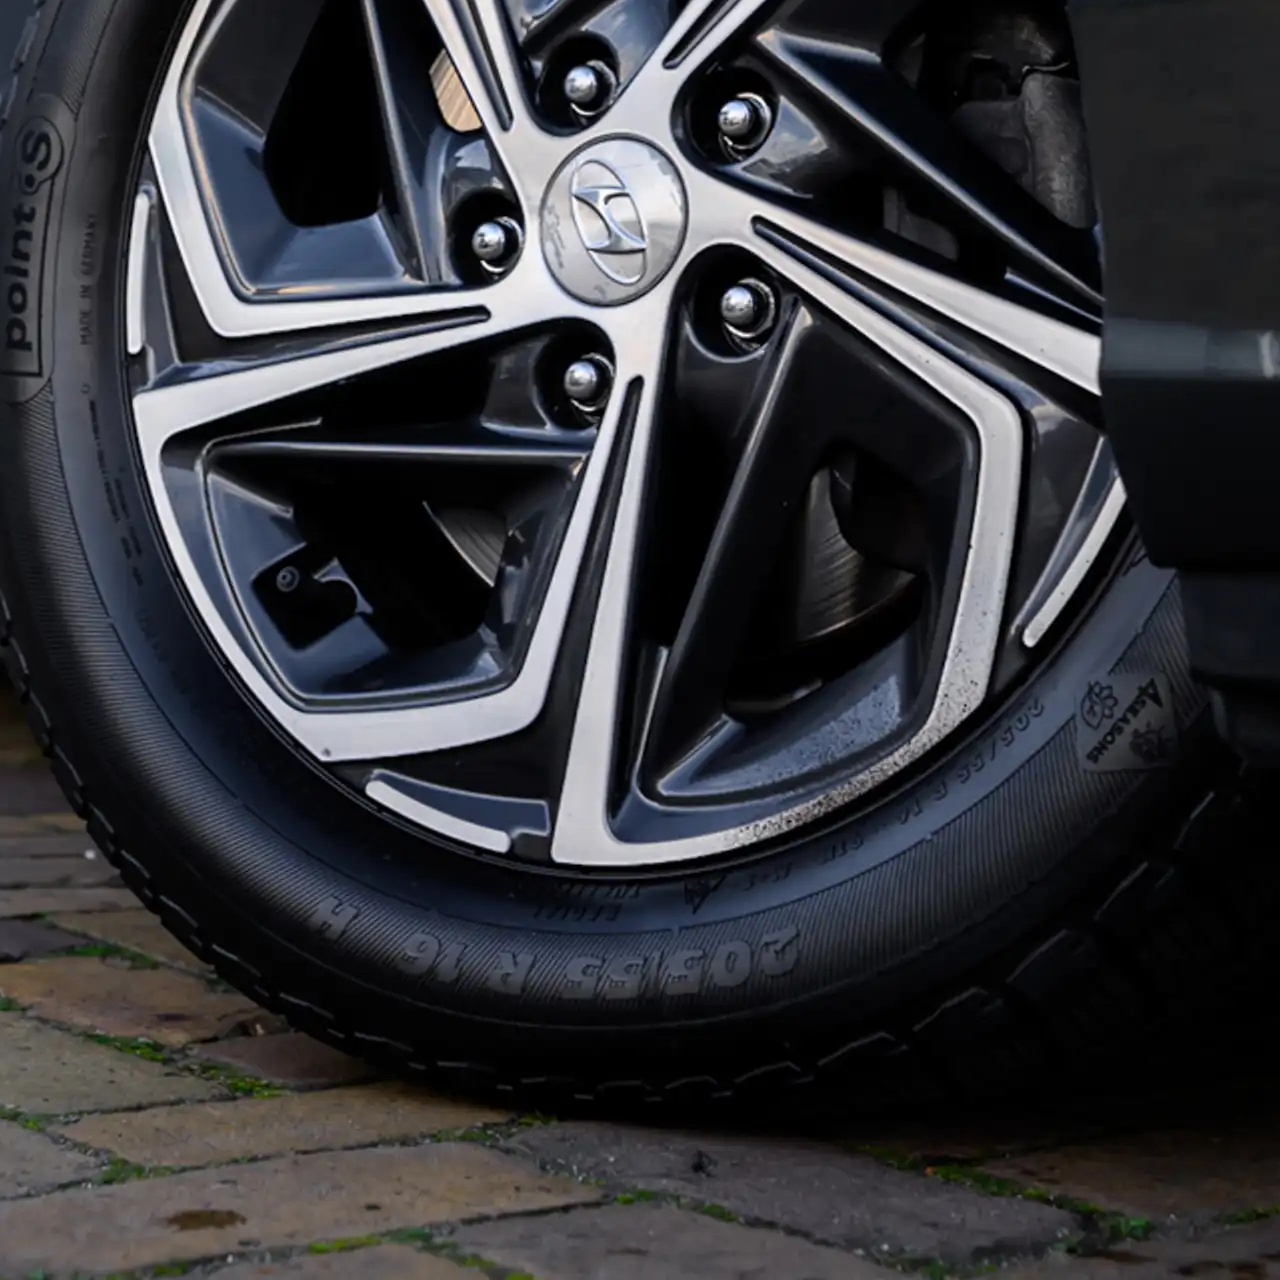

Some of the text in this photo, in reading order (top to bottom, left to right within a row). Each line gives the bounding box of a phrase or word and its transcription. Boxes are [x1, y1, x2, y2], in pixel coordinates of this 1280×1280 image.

[3, 202, 37, 352] point
[310, 894, 360, 941] H
[396, 932, 469, 985] 16
[486, 950, 538, 996] R
